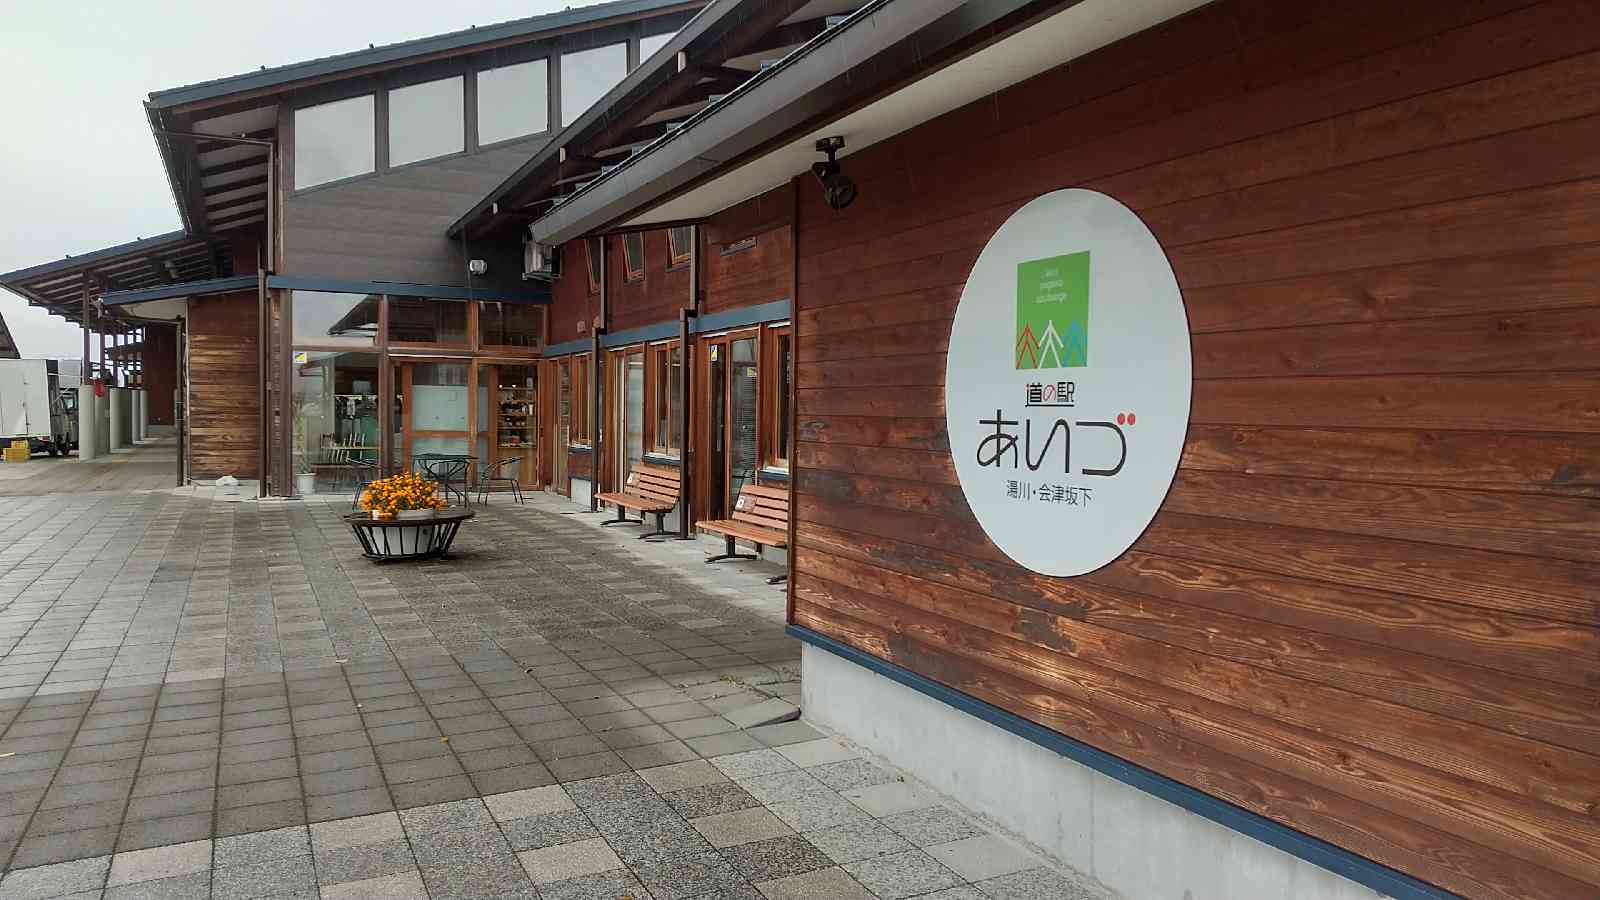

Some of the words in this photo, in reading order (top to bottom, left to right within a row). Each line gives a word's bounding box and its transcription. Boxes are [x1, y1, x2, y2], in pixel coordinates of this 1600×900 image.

[1025, 381, 1075, 407] 道の駅
[977, 409, 1136, 476] あいづ
